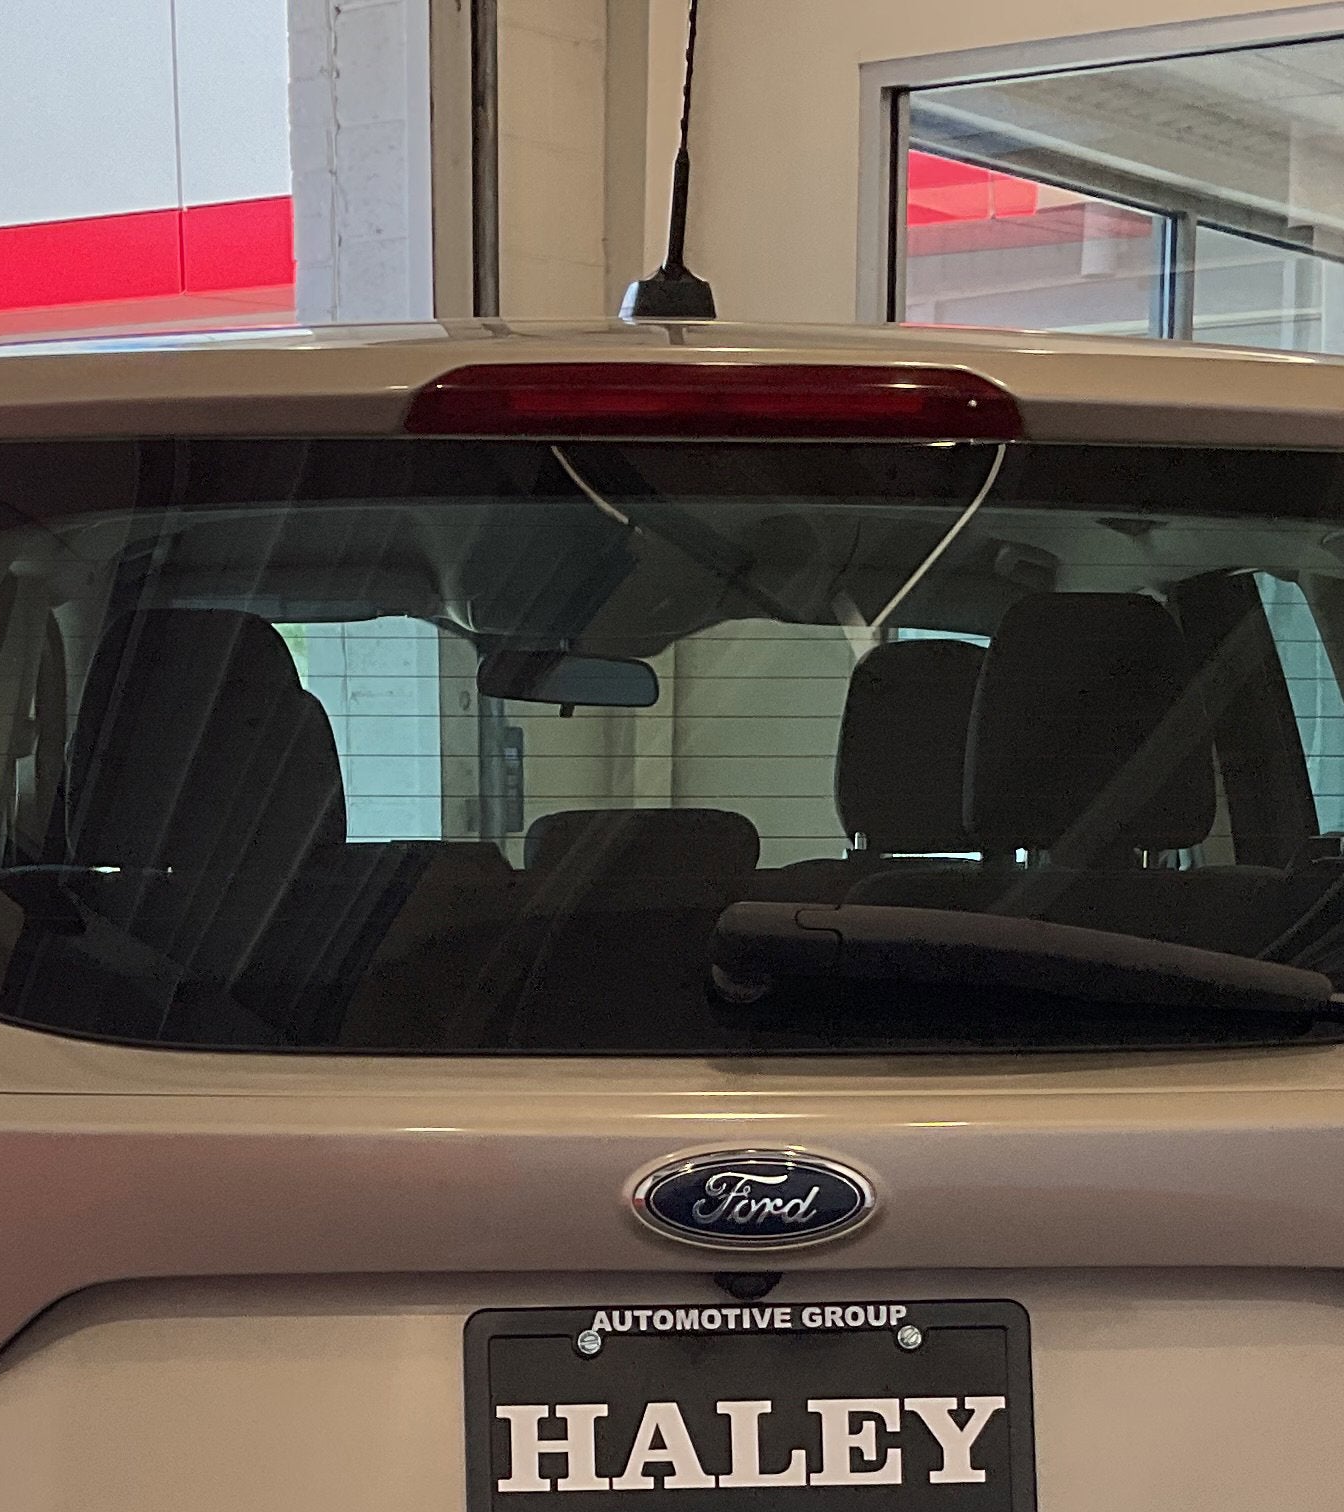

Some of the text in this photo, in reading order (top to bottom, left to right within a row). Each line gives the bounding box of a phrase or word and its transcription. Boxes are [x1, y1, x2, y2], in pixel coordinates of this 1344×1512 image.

[692, 1171, 820, 1224] Ford
[592, 1305, 906, 1332] AUTOMOTIVE GROUP
[496, 1396, 1006, 1493] HALEY
